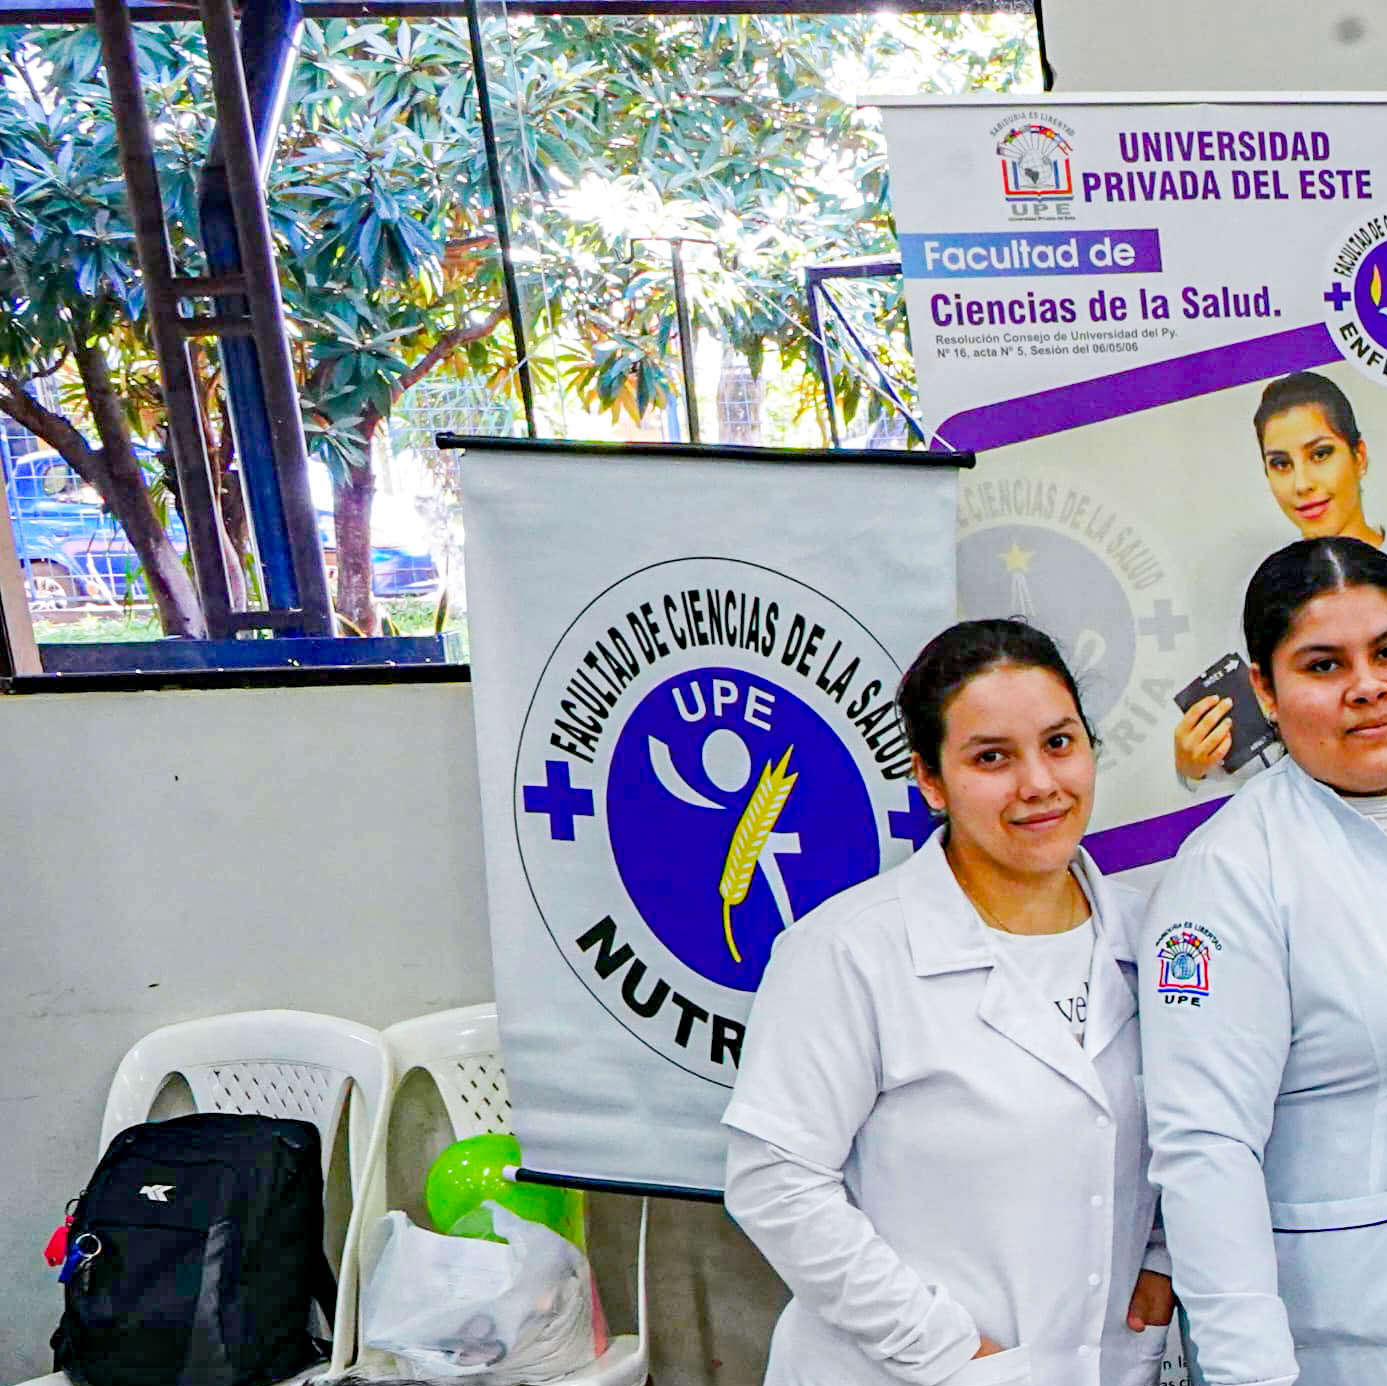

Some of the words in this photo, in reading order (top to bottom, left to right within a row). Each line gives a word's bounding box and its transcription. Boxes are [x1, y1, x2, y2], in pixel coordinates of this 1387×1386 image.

[1118, 130, 1331, 164] UNIVERSIDAD
[1082, 170, 1224, 203] PRIVADA
[1232, 168, 1290, 201] DEL
[1300, 168, 1374, 199] ESTE
[1011, 203, 1071, 216] UPE
[924, 237, 1079, 271] Facultad
[1088, 236, 1136, 267] de
[1333, 227, 1372, 279] FACULTAD
[1367, 217, 1386, 241] DE
[930, 291, 1077, 326] Ciencias
[1088, 290, 1128, 322] de
[1138, 287, 1171, 320] la
[1182, 286, 1282, 320] Salud.
[935, 332, 1000, 346] Resolución
[1003, 331, 1051, 344] Consejo
[1053, 330, 1068, 342] de
[1070, 328, 1138, 342] Universidad
[1141, 327, 1159, 339] del
[1160, 328, 1178, 341] Py.
[972, 347, 998, 359] acta
[1030, 343, 1070, 357] Sesión
[1072, 343, 1090, 355] del
[1091, 341, 1139, 355] 06/05/06
[971, 478, 1059, 523] CIENCIAS
[1061, 489, 1092, 530] DE
[1084, 505, 1118, 548] LA
[1106, 525, 1165, 591] SALUD
[550, 628, 639, 764] FACULTAD
[627, 603, 671, 665] DE
[664, 586, 779, 658] CIENCIAS
[781, 614, 825, 678] DE
[815, 638, 863, 704] LA
[846, 679, 914, 782] SALUD
[670, 677, 778, 732] UPE
[1164, 994, 1201, 1008] UPE
